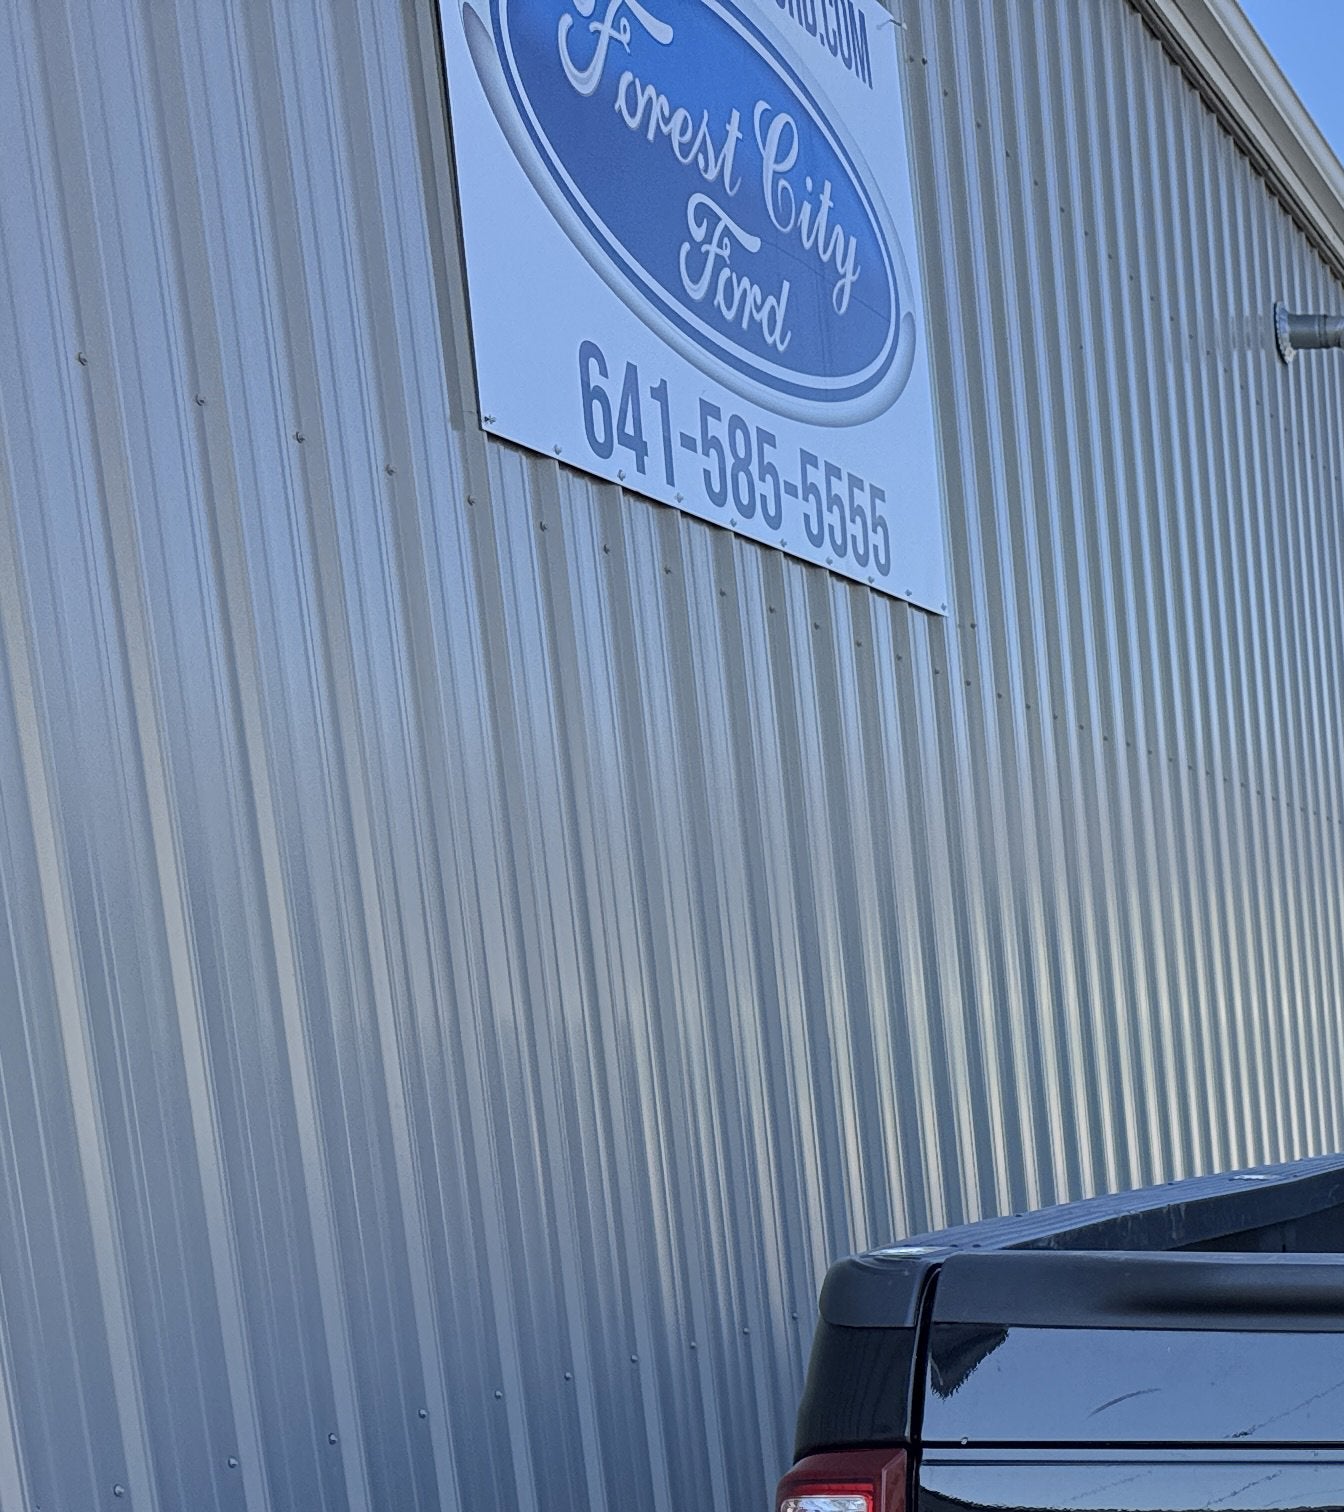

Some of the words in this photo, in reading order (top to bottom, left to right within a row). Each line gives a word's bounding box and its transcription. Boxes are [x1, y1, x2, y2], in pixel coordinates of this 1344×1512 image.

[557, 0, 744, 197] Forest
[753, 100, 860, 315] City
[679, 192, 791, 351] Ford
[578, 340, 892, 577] 641-585-5555
